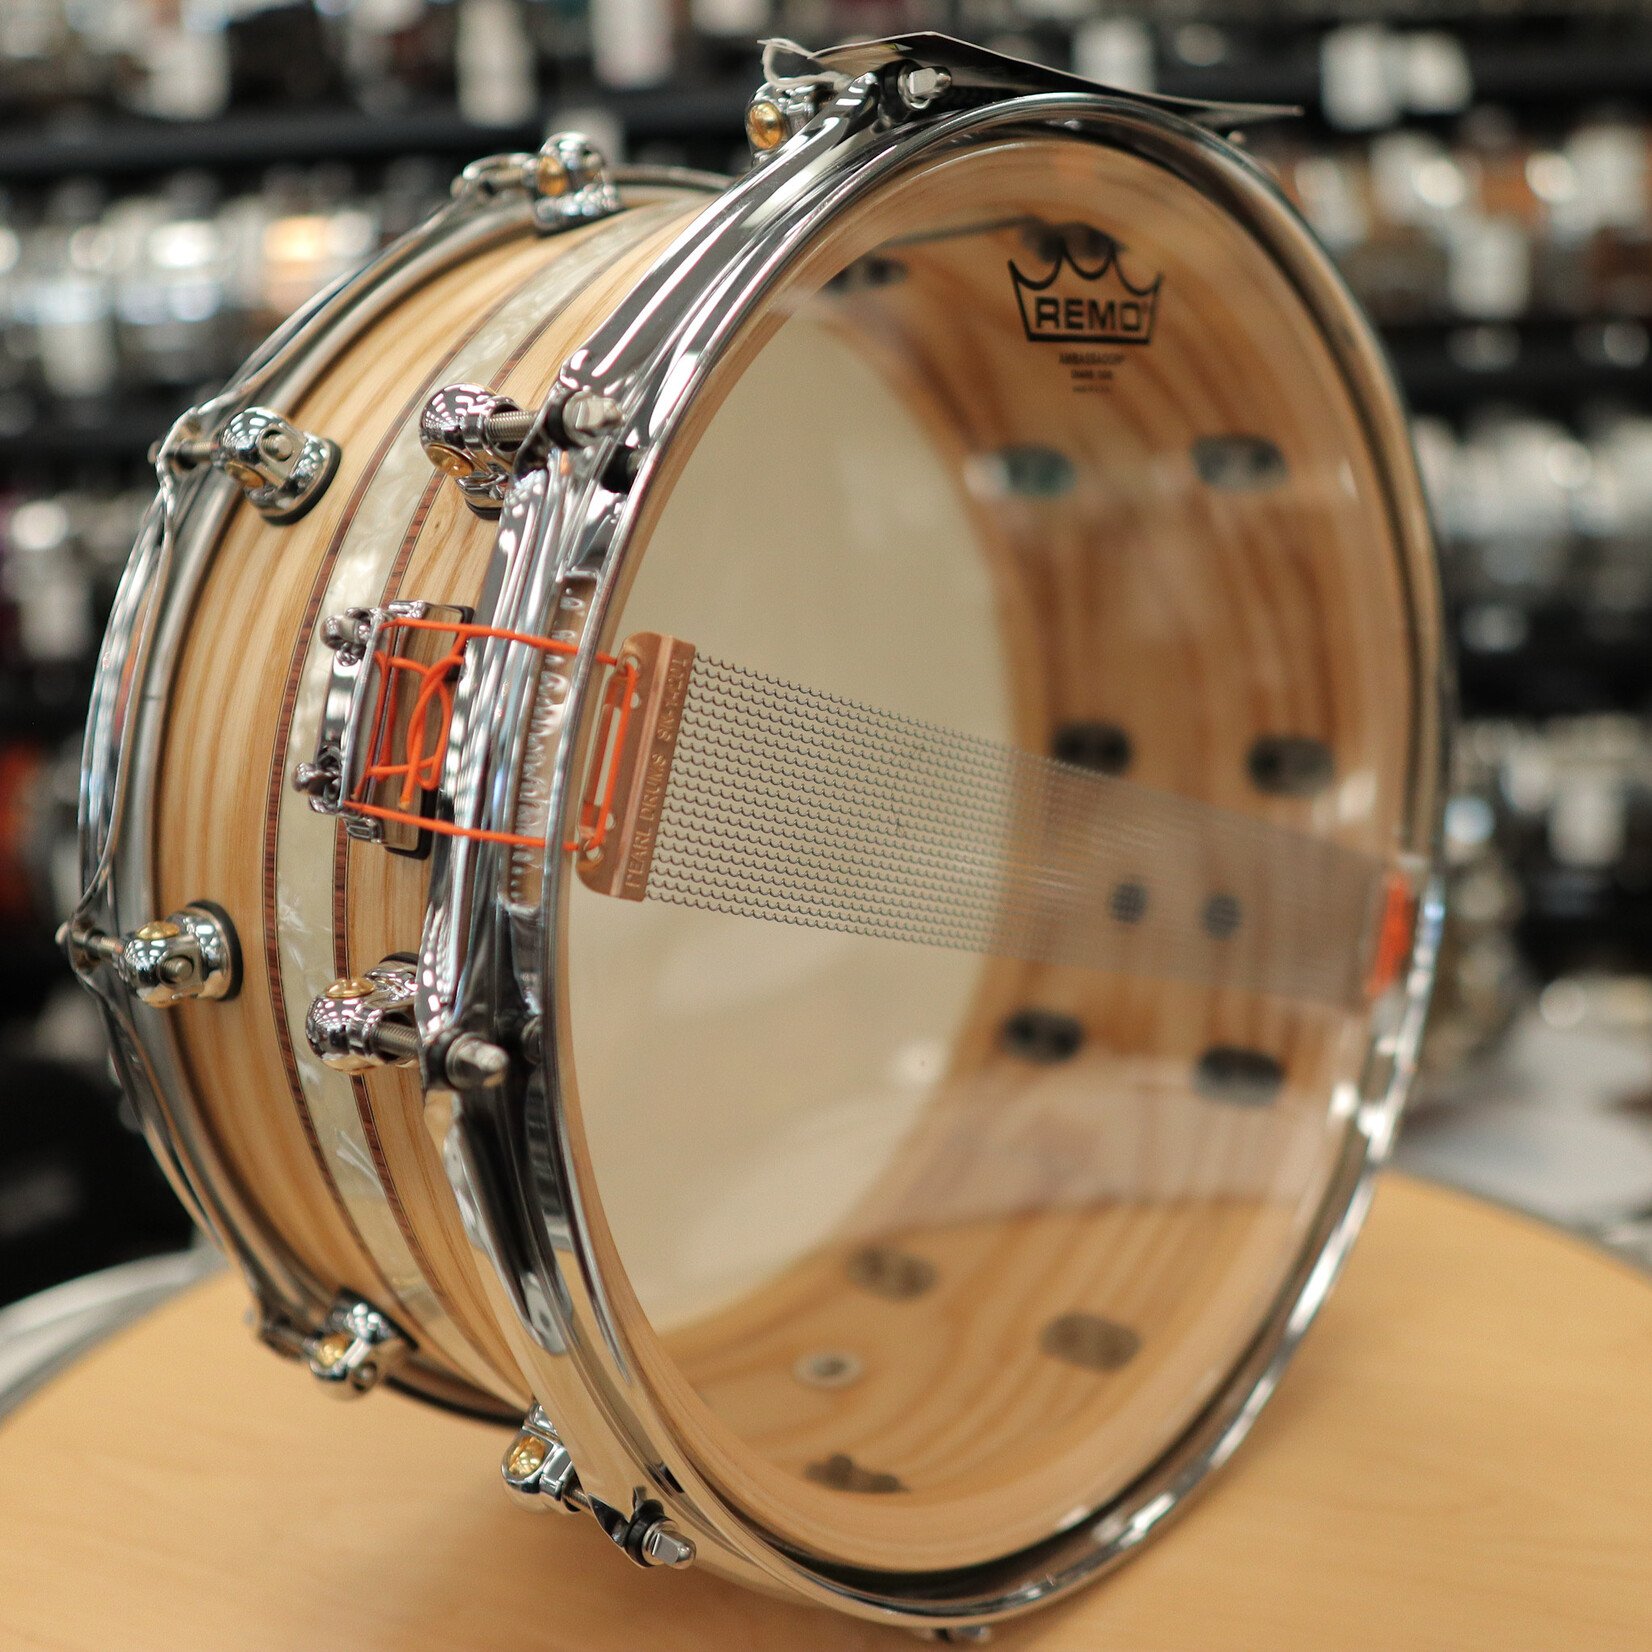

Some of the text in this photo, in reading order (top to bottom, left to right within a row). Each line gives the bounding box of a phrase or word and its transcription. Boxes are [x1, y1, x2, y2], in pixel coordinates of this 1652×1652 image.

[1035, 297, 1141, 332] REMO
[625, 831, 651, 888] PEARL
[639, 753, 667, 822] DRUMS
